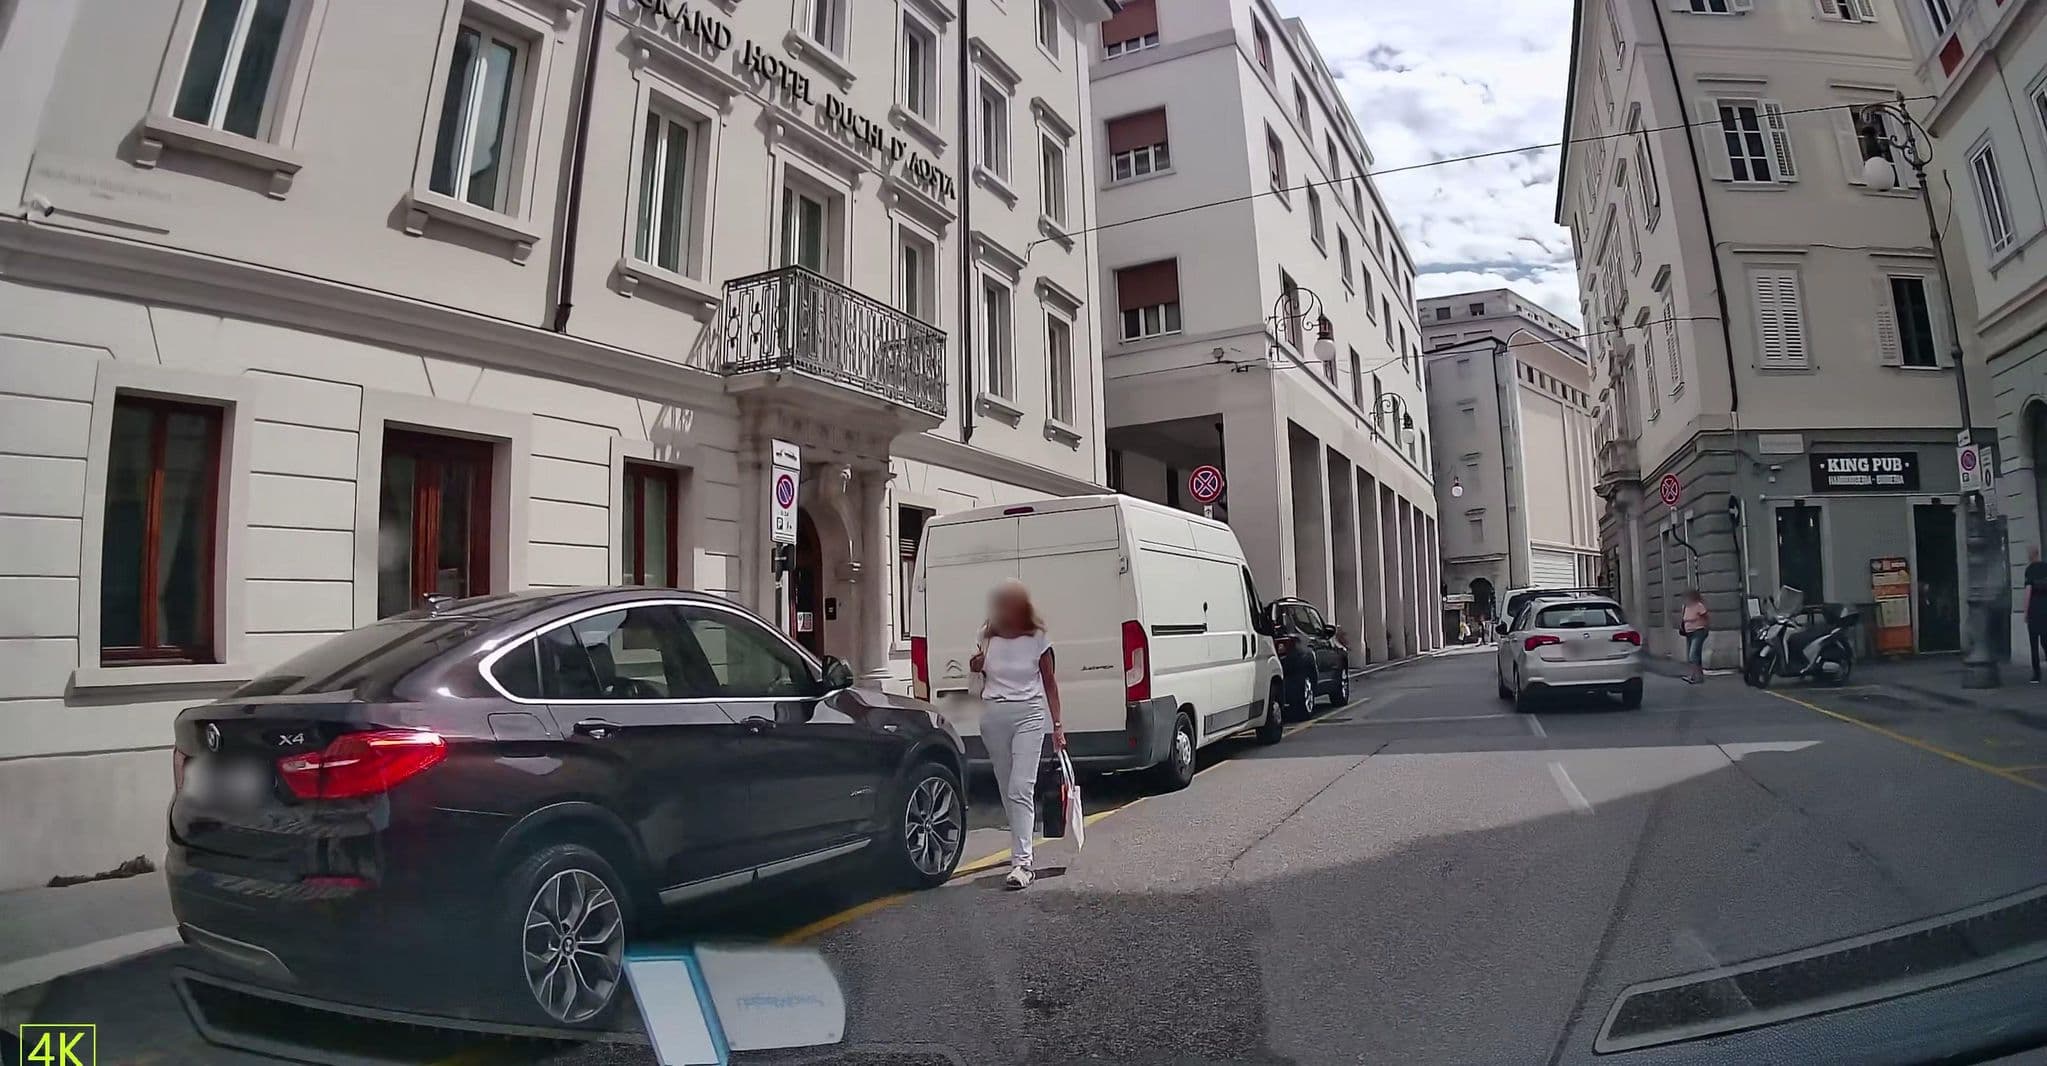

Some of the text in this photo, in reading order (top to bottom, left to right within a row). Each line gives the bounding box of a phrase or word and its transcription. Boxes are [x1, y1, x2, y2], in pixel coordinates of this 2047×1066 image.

[743, 39, 814, 106] HOTEL
[826, 93, 883, 152] DUCHI
[908, 151, 957, 201] AOSTA
[1827, 457, 1903, 473] KING PUB
[278, 732, 305, 746] X4
